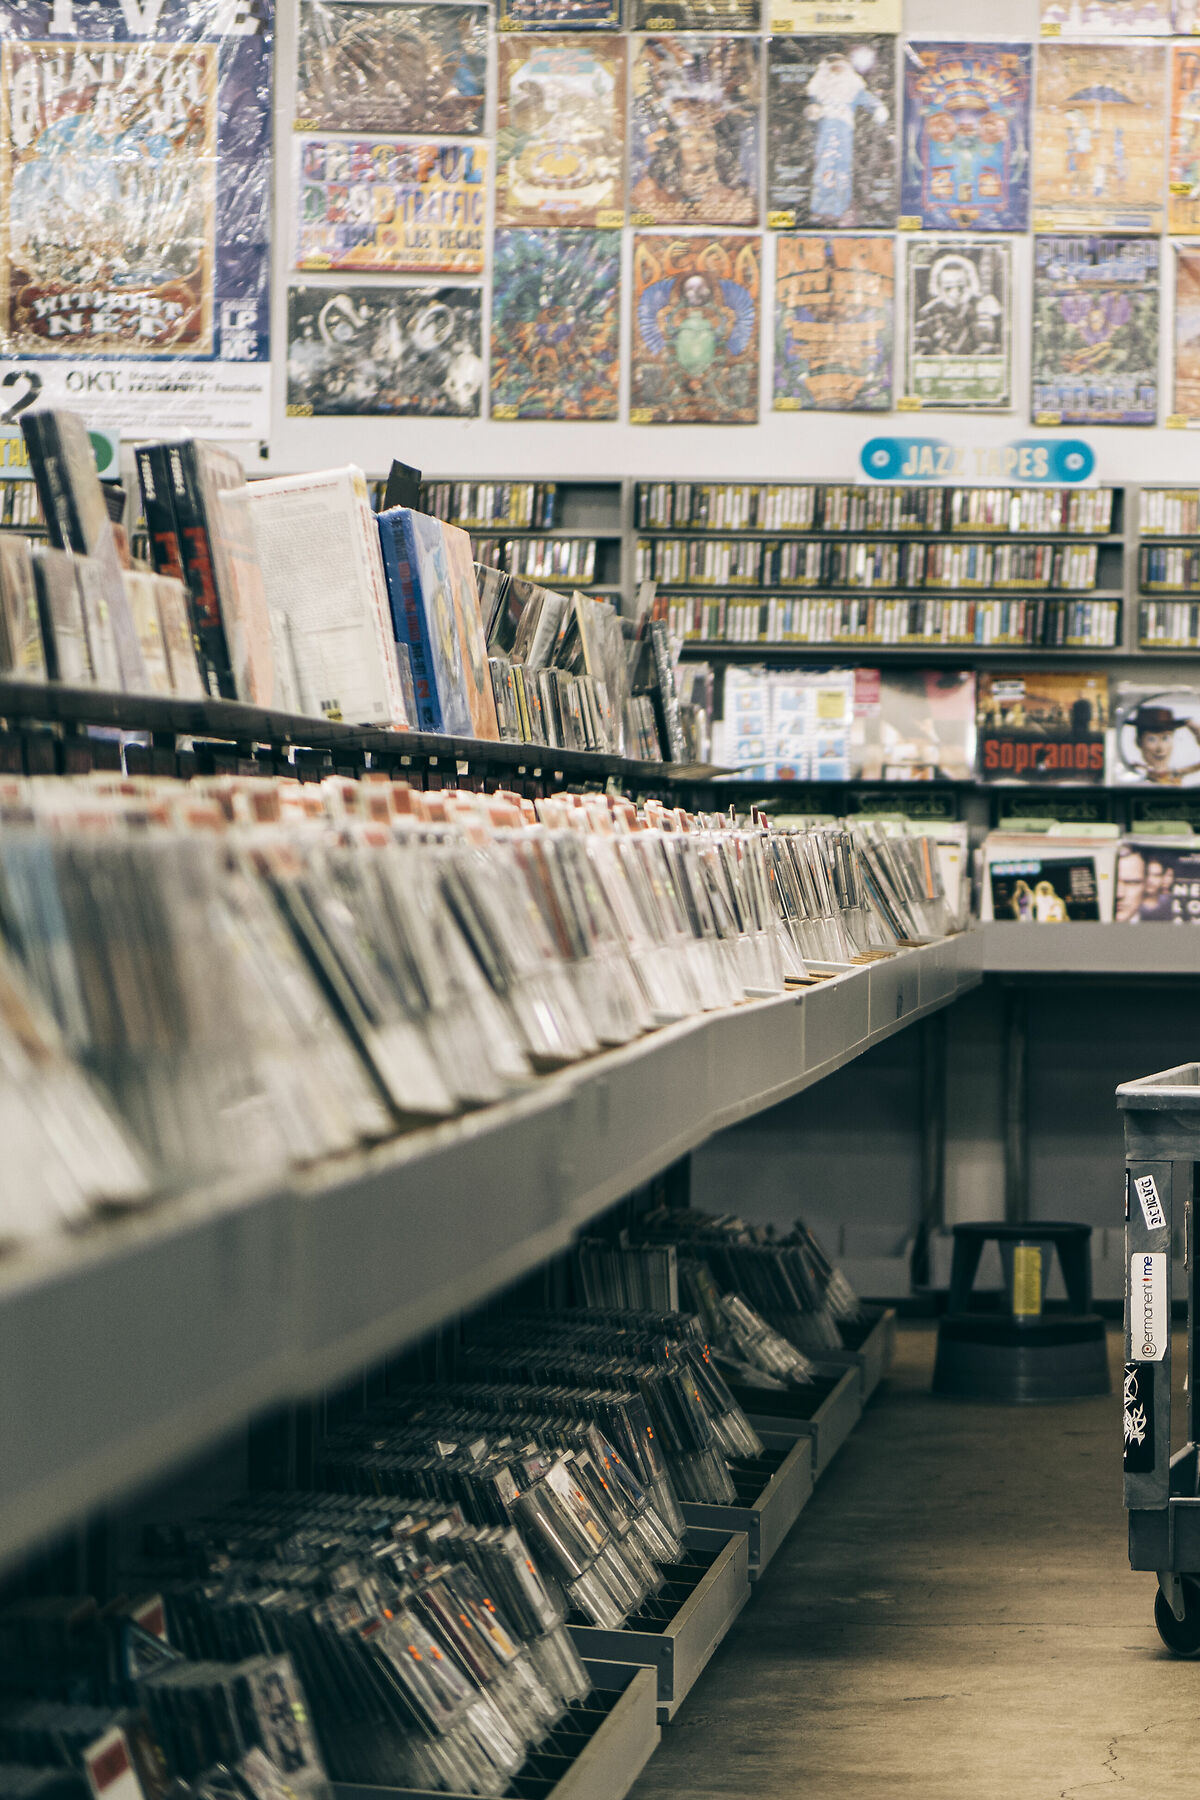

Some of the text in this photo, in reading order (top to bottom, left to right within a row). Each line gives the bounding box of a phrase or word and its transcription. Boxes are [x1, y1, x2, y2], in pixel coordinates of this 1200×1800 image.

[221, 311, 258, 330] LP
[902, 445, 1049, 478] JAZZ TAPES
[984, 739, 1104, 774] Sopranos
